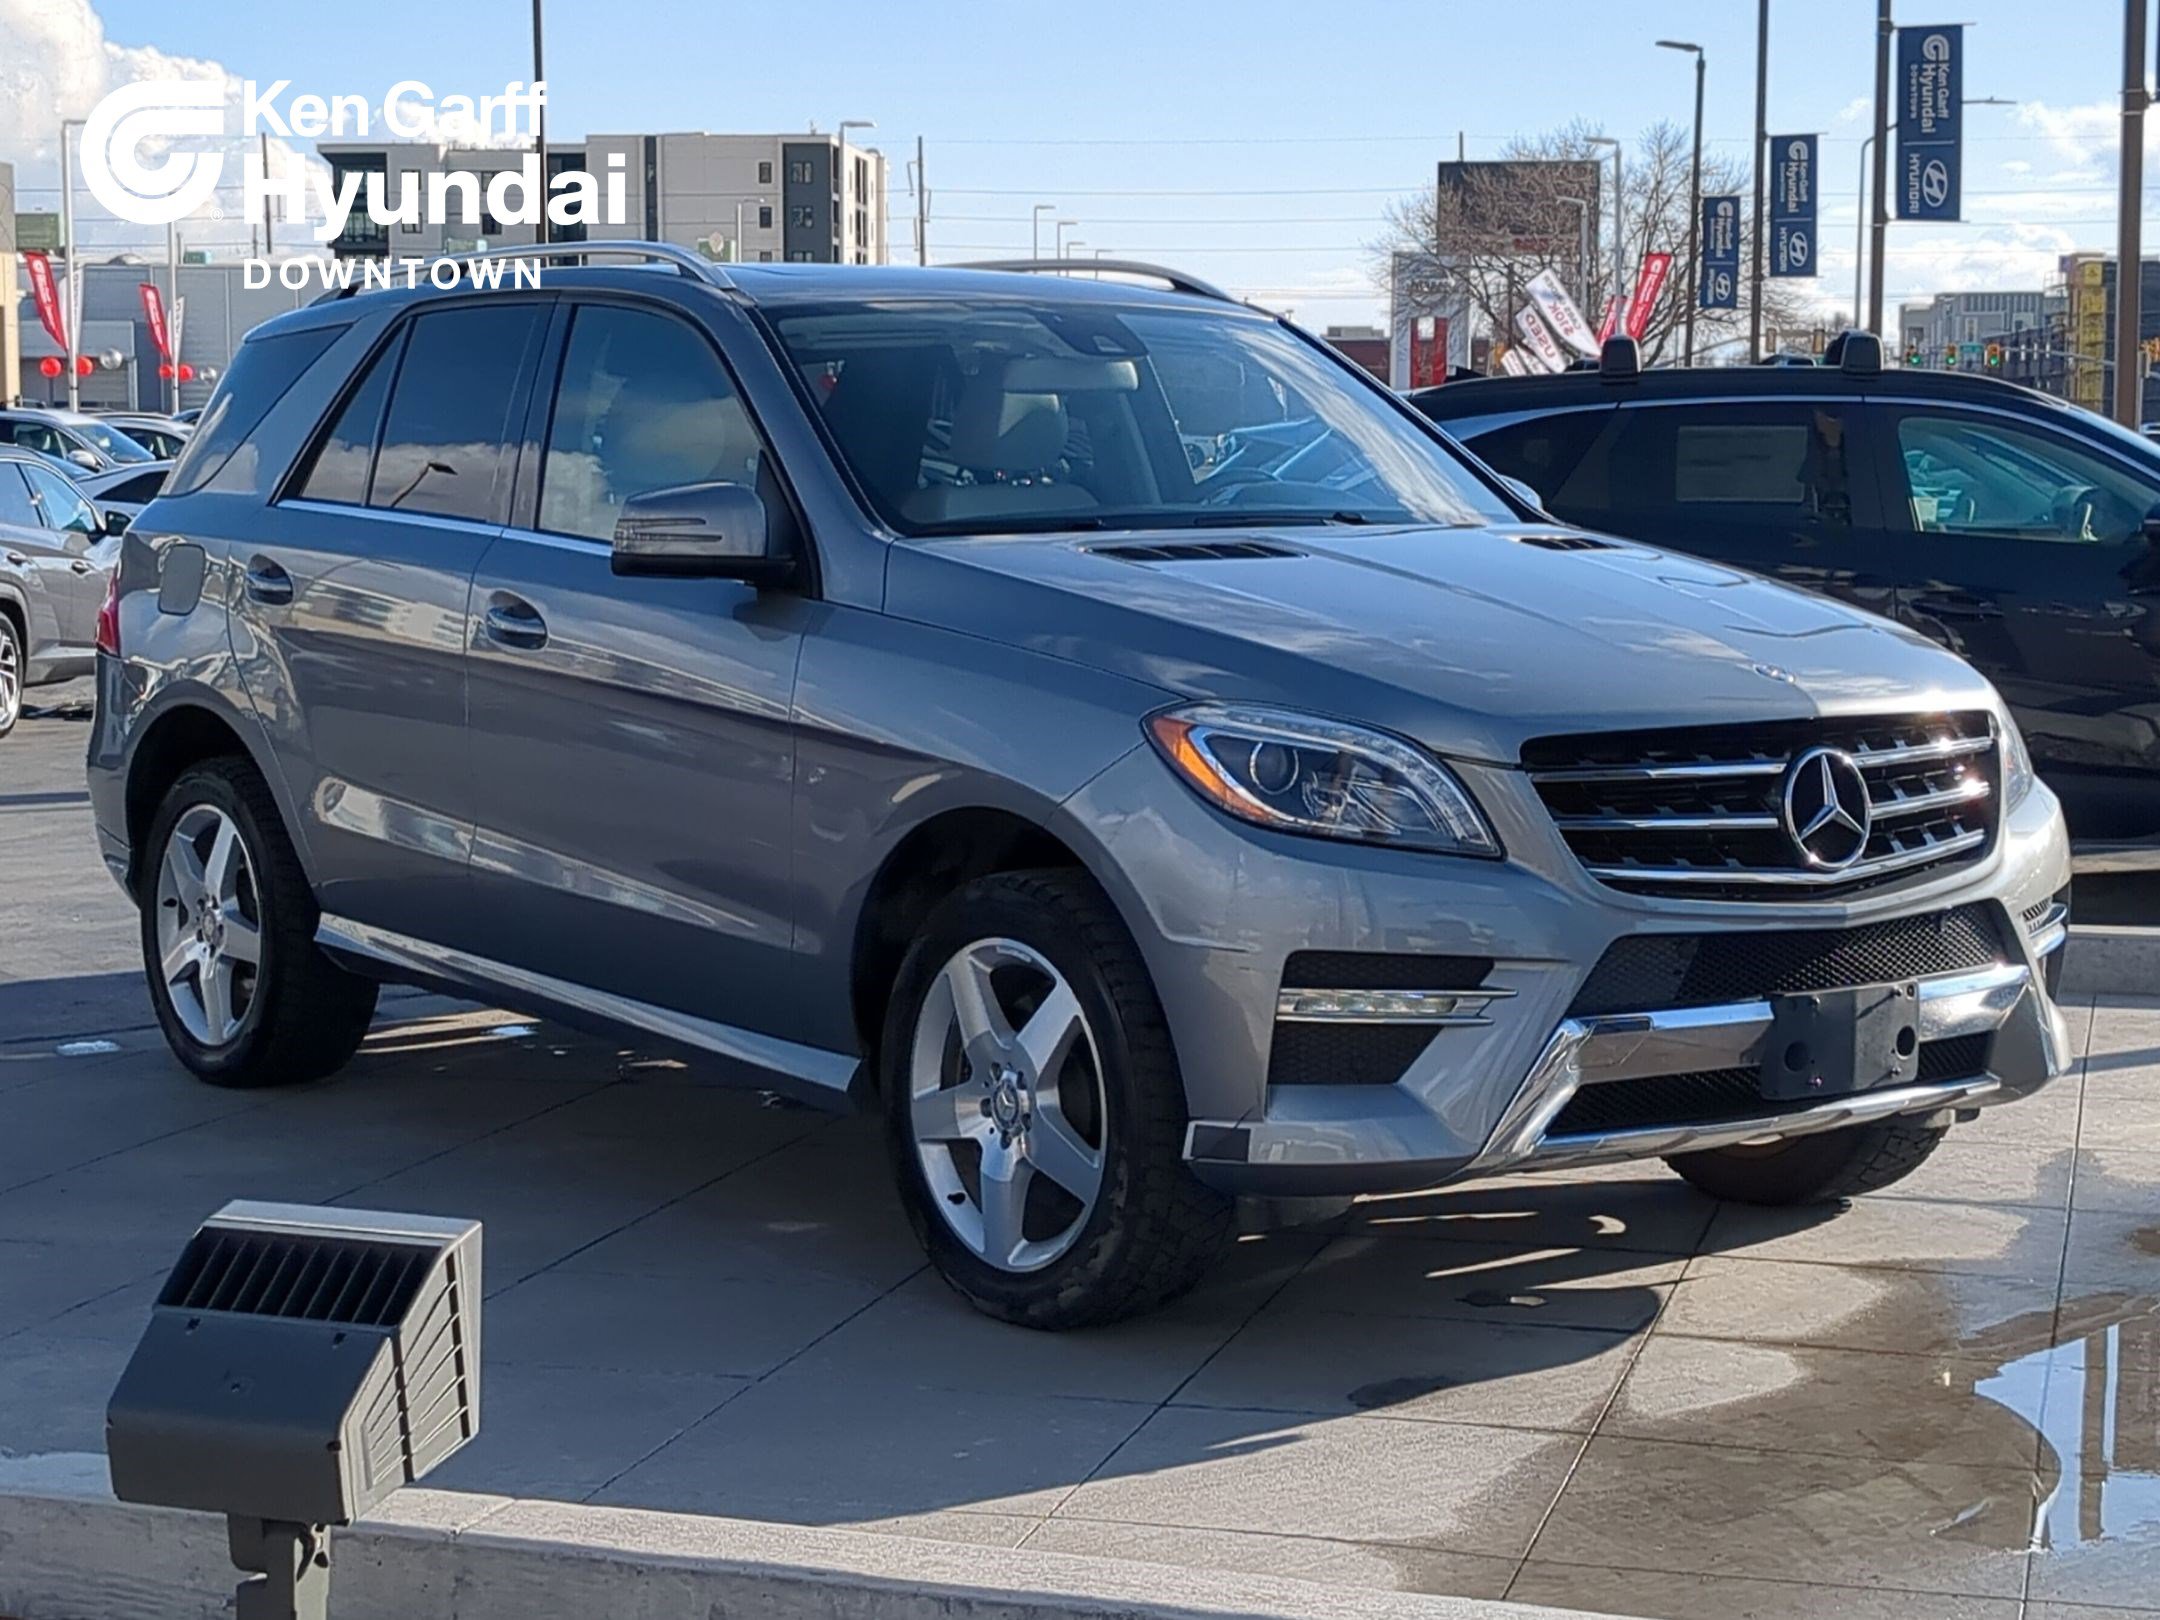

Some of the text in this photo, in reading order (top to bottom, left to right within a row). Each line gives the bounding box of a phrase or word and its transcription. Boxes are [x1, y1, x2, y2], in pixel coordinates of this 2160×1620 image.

[1919, 63, 1937, 133] Hyundai
[1937, 63, 1950, 119] Ken Garff
[1909, 153, 1920, 214] HYUNDAI
